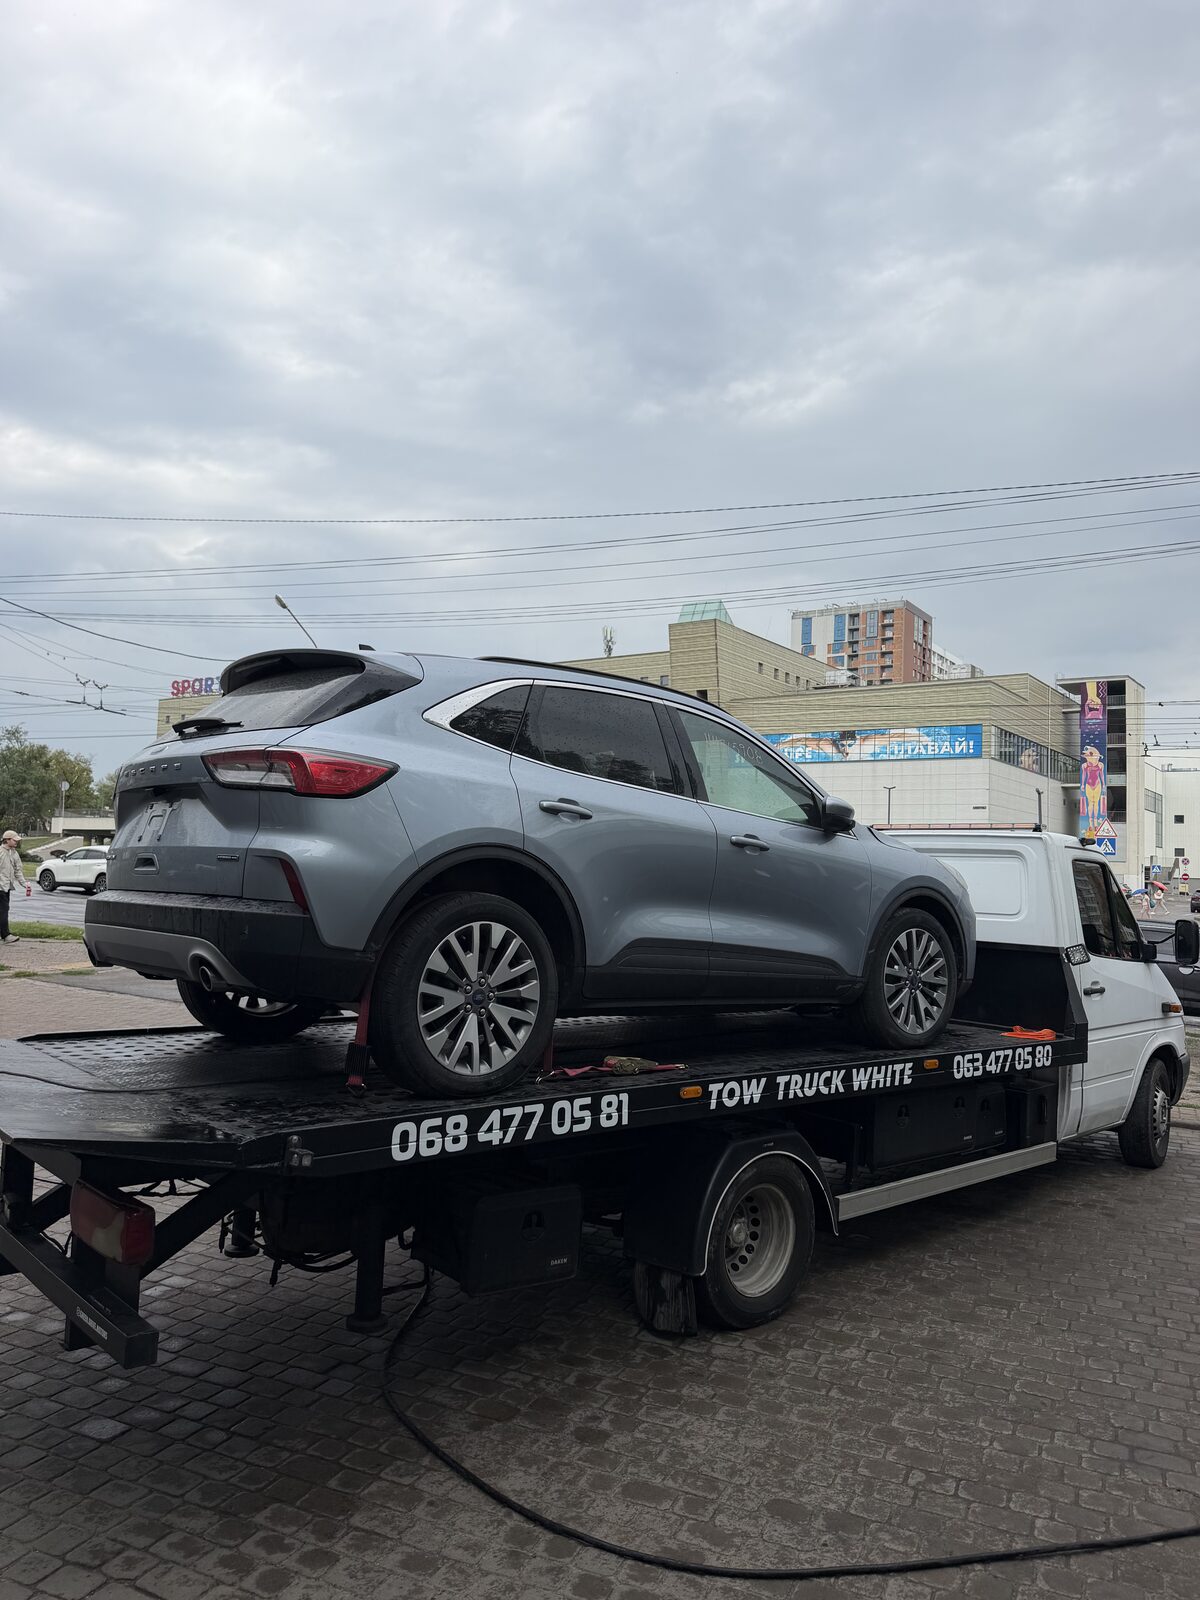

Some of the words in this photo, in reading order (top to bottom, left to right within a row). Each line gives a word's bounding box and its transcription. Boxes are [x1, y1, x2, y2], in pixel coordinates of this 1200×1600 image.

[953, 1052, 983, 1079] 063
[985, 1048, 1013, 1074] 477
[1014, 1046, 1033, 1070] 05
[1035, 1044, 1052, 1068] 80
[708, 1077, 767, 1110] TOW
[776, 1069, 846, 1100] TRUCK
[852, 1062, 914, 1091] WHITE
[391, 1114, 468, 1162] 068
[477, 1103, 545, 1146] 477
[551, 1096, 592, 1135] 05
[600, 1092, 629, 1128] 81
